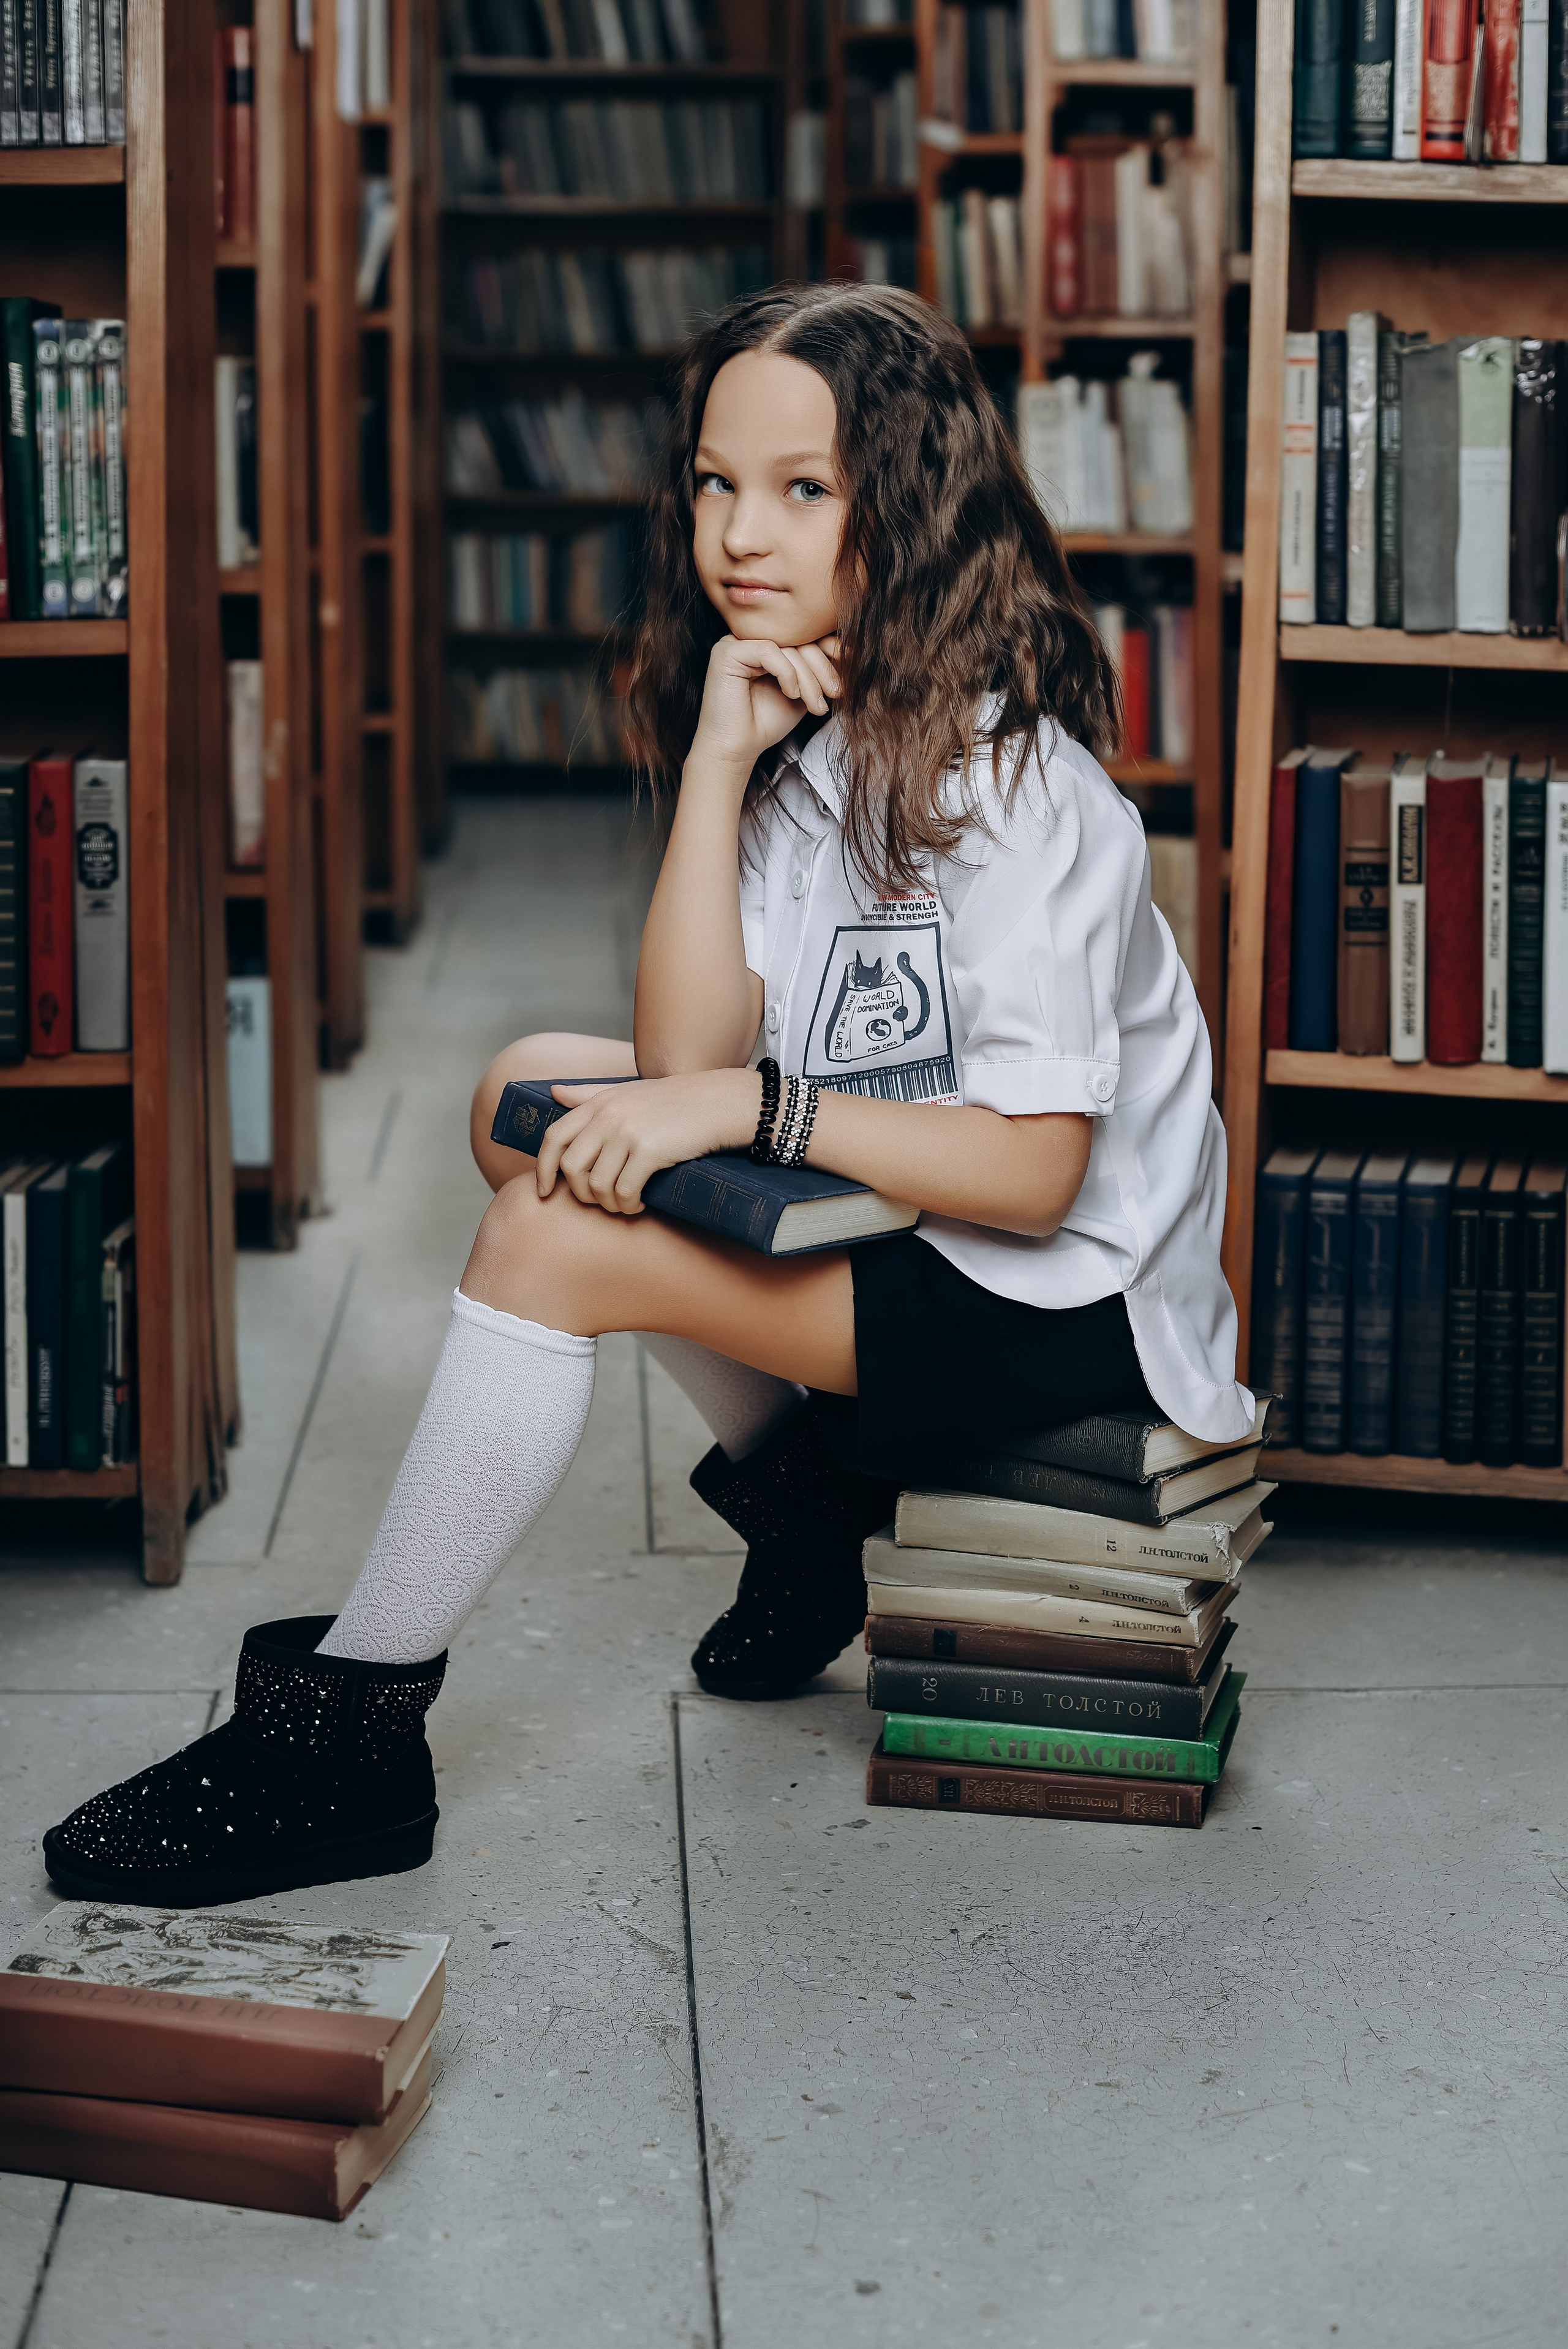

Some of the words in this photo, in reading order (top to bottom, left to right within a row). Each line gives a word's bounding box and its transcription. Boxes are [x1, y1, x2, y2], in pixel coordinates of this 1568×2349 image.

[872, 903, 897, 912] FUTURE
[899, 901, 937, 912] WORLD
[896, 911, 938, 921] STRENGH
[845, 994, 856, 1012] SAVE
[863, 990, 895, 1003] WORLD
[858, 998, 900, 1012] DOMINATION
[839, 1016, 847, 1029] THE
[835, 1031, 843, 1058] WORLD
[1106, 1539, 1117, 1552] 12
[922, 1677, 938, 1702] 20
[976, 1686, 1023, 1705] ЛЕВ
[1043, 1693, 1162, 1719] ТОЛСТОЙ
